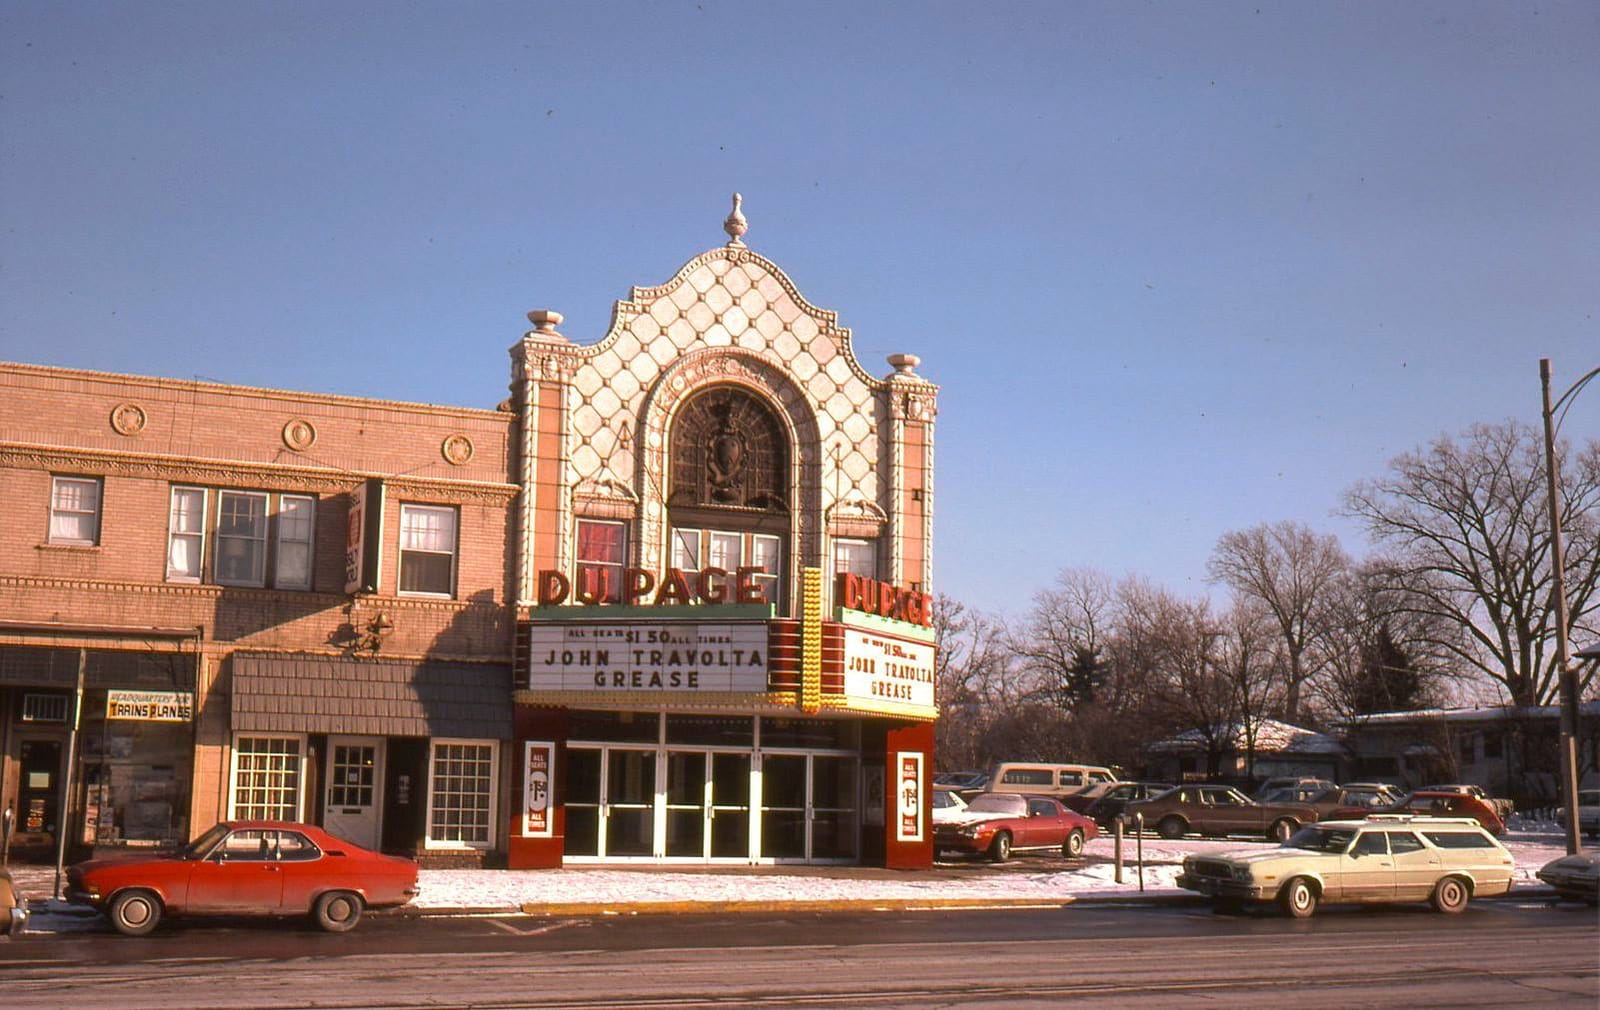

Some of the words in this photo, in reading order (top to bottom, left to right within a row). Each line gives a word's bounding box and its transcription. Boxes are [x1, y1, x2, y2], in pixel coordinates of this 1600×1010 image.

[538, 568, 609, 606] DU
[624, 566, 768, 606] PAGE
[879, 581, 934, 629] PAGE
[568, 629, 586, 638] ALL
[671, 636, 691, 645] ALL
[544, 649, 610, 666] JOHN
[633, 649, 763, 667] TRAVOLTA
[594, 670, 700, 688] GREASE
[848, 656, 876, 674] JOHN
[885, 662, 932, 684] TRAVOLTA
[871, 681, 913, 700] GREASE
[111, 702, 149, 717] TRAINS
[150, 703, 191, 718] PLANES
[533, 754, 544, 762] ALL
